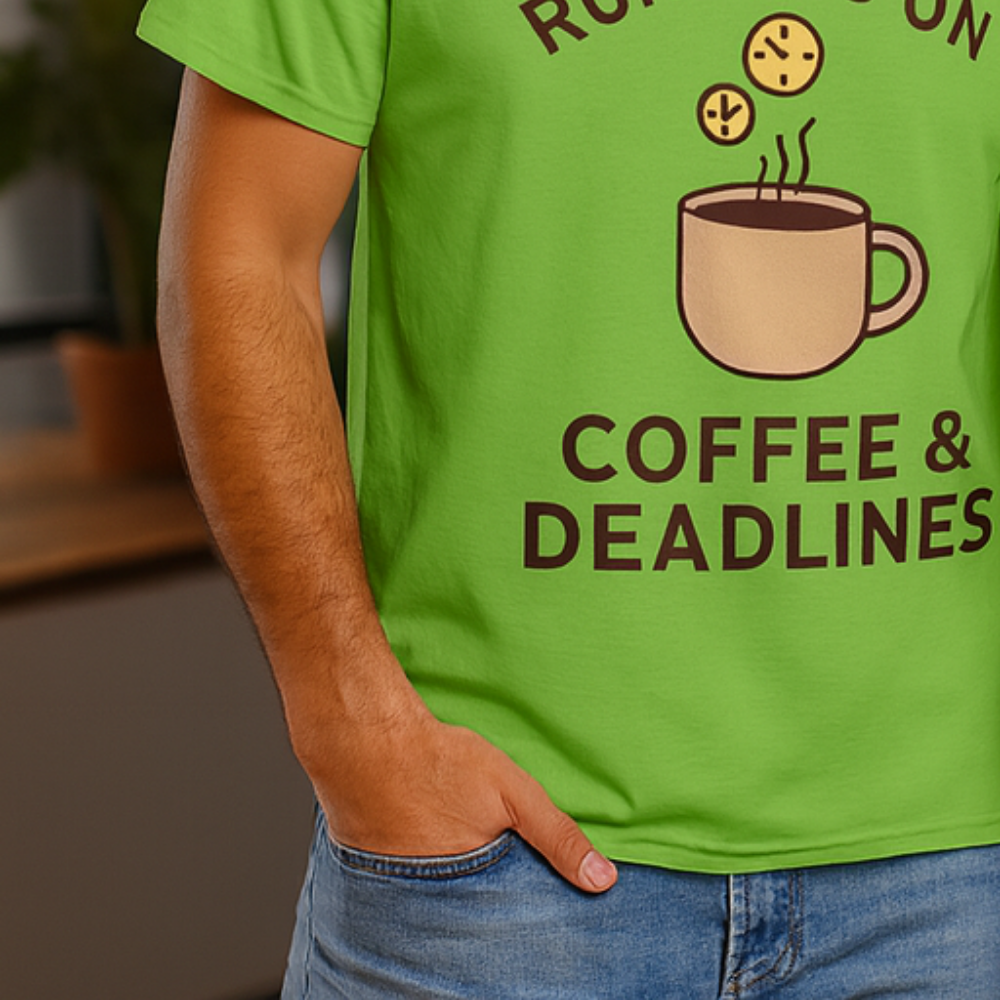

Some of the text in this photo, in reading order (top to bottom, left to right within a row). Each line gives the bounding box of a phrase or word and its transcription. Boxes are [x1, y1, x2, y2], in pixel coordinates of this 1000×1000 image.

[560, 409, 973, 485] COFFEE &
[522, 486, 994, 573] DEADLINES
